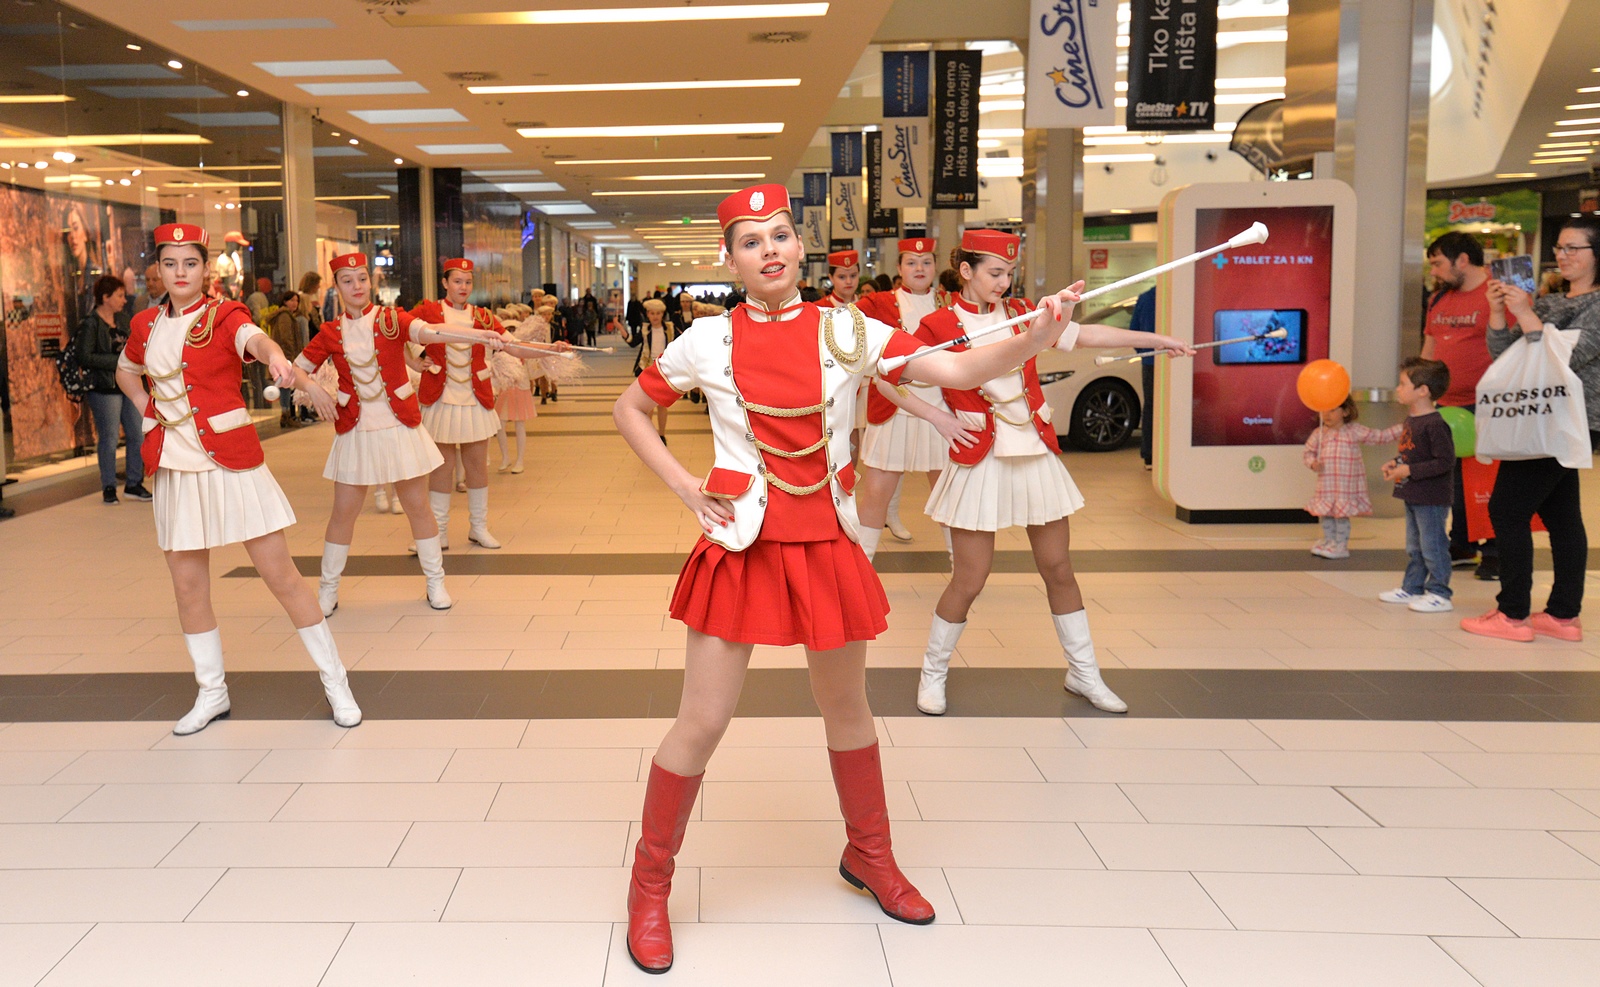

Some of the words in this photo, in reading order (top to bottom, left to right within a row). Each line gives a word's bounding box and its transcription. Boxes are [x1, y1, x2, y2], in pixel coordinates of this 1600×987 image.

[1148, 28, 1170, 73] Tko
[1174, 12, 1197, 70] ništa
[1041, 0, 1092, 108] CineSt
[946, 60, 957, 97] nema
[958, 62, 972, 123] televiziji?
[944, 100, 956, 117] da
[1136, 102, 1175, 113] CineStar
[1189, 102, 1209, 117] TV
[943, 121, 956, 151] kaže
[959, 126, 969, 143] na
[888, 124, 915, 198] CineStar
[943, 154, 955, 178] Tko
[956, 146, 968, 177] ništa
[836, 182, 856, 232] CineStar
[965, 193, 975, 201] TV
[1232, 255, 1271, 265] TABLET
[1273, 255, 1288, 265] ZA
[1289, 255, 1295, 265] 1
[1297, 255, 1313, 265] KN
[1431, 310, 1481, 325] Arsenal
[1479, 385, 1571, 405] ACCESSOR
[1242, 414, 1273, 425] Optima
[1491, 403, 1553, 418] DONNA
